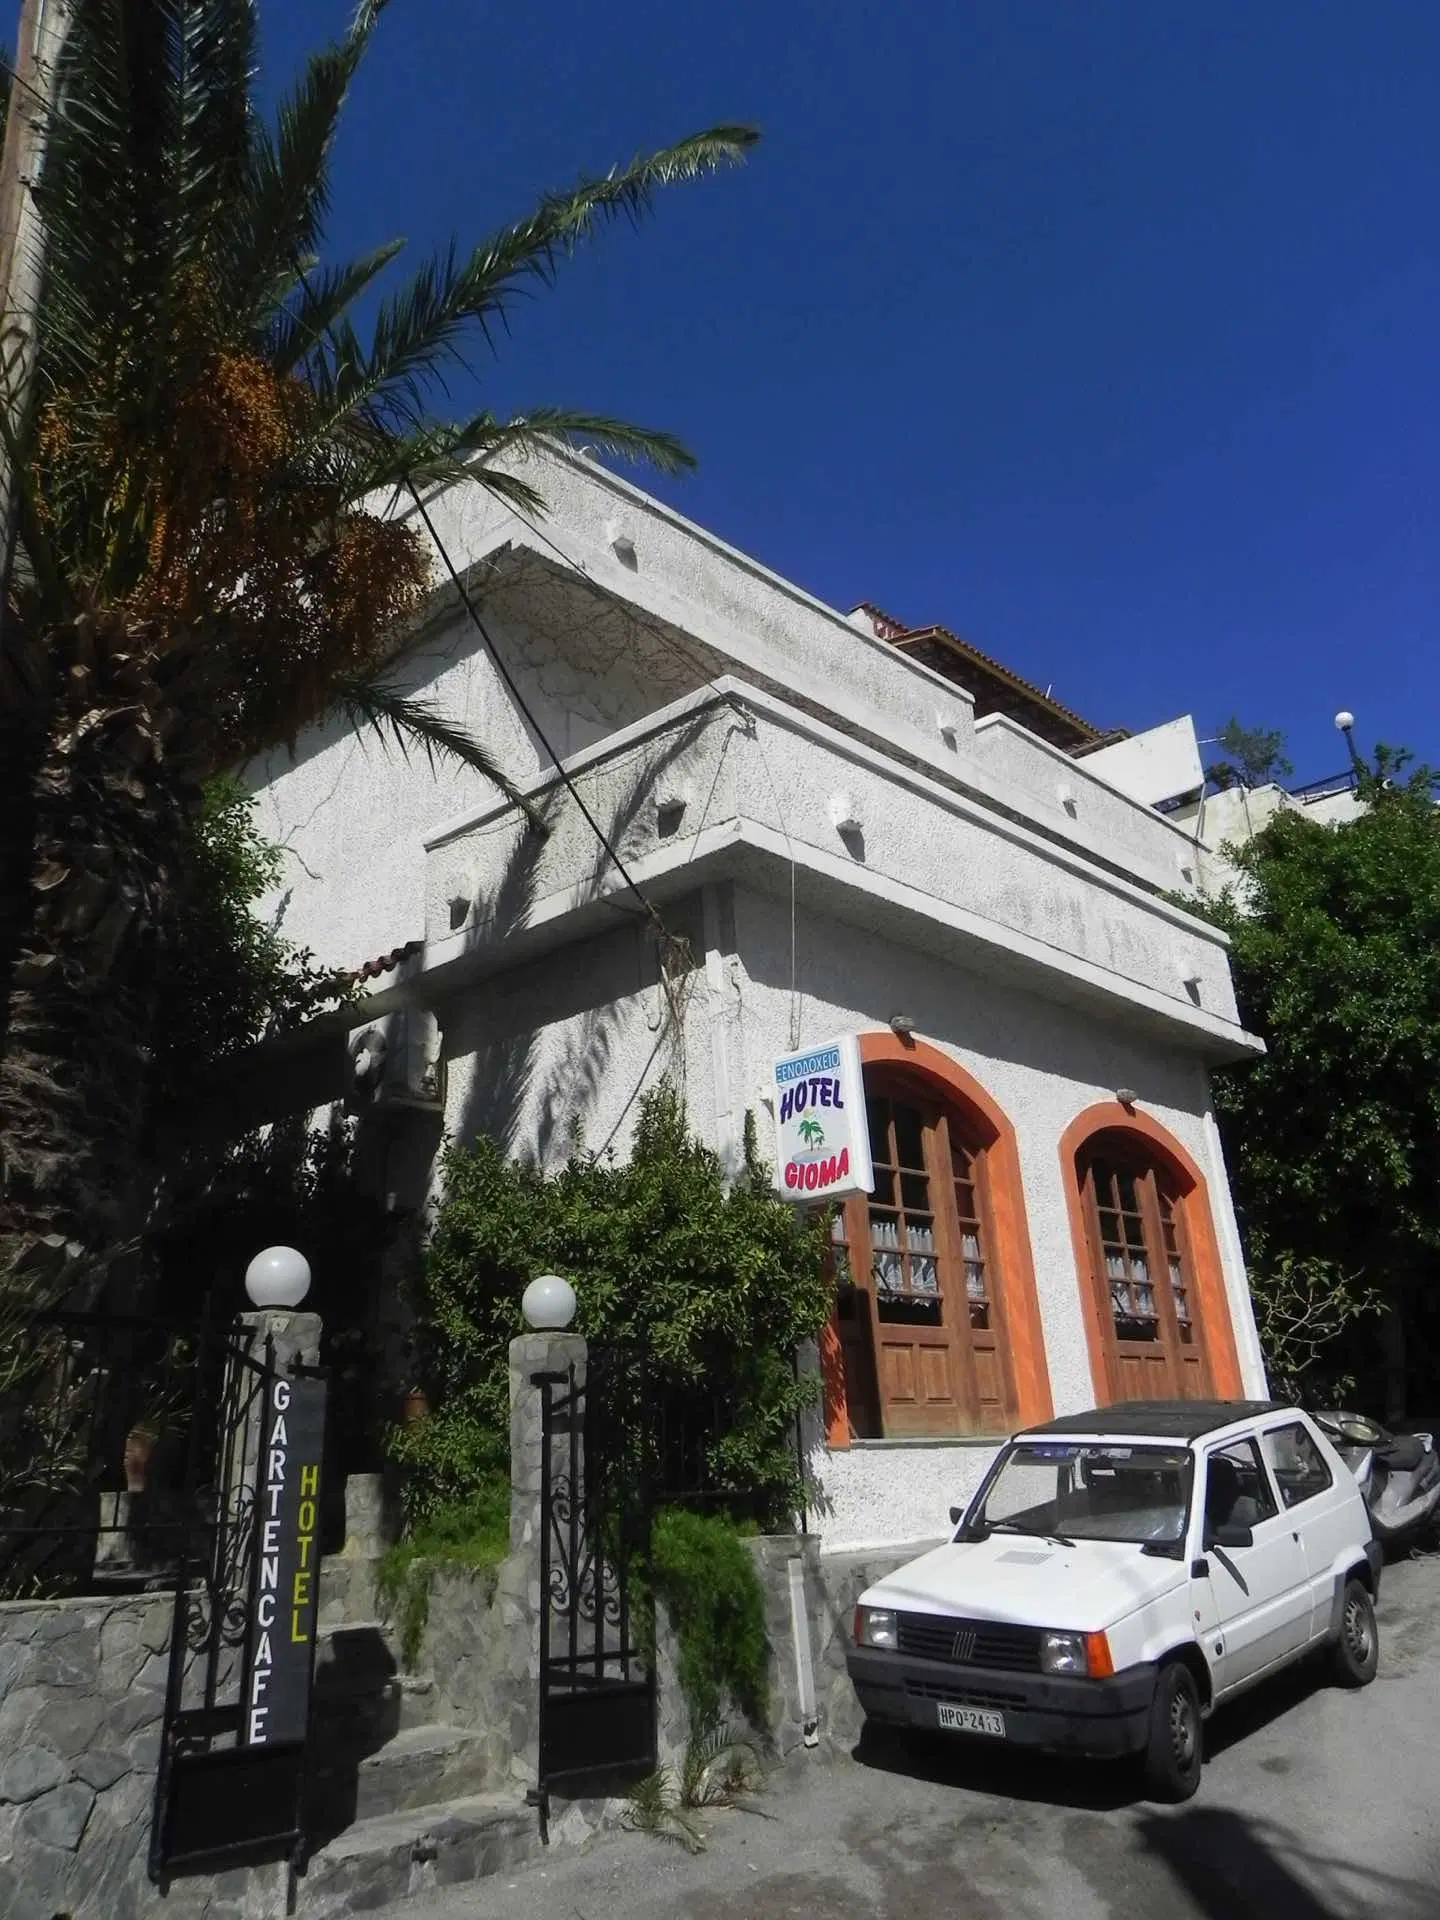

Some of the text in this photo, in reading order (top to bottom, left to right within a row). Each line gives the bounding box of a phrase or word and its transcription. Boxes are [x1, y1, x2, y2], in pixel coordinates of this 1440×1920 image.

[776, 1051, 839, 1081] ΞΕΝΟΔΟΧΕΙΟ
[780, 1077, 844, 1124] HOTEL
[784, 1147, 849, 1191] GIOMA
[248, 1380, 291, 1745] GARTENCAFE
[291, 1464, 319, 1643] HOTEL
